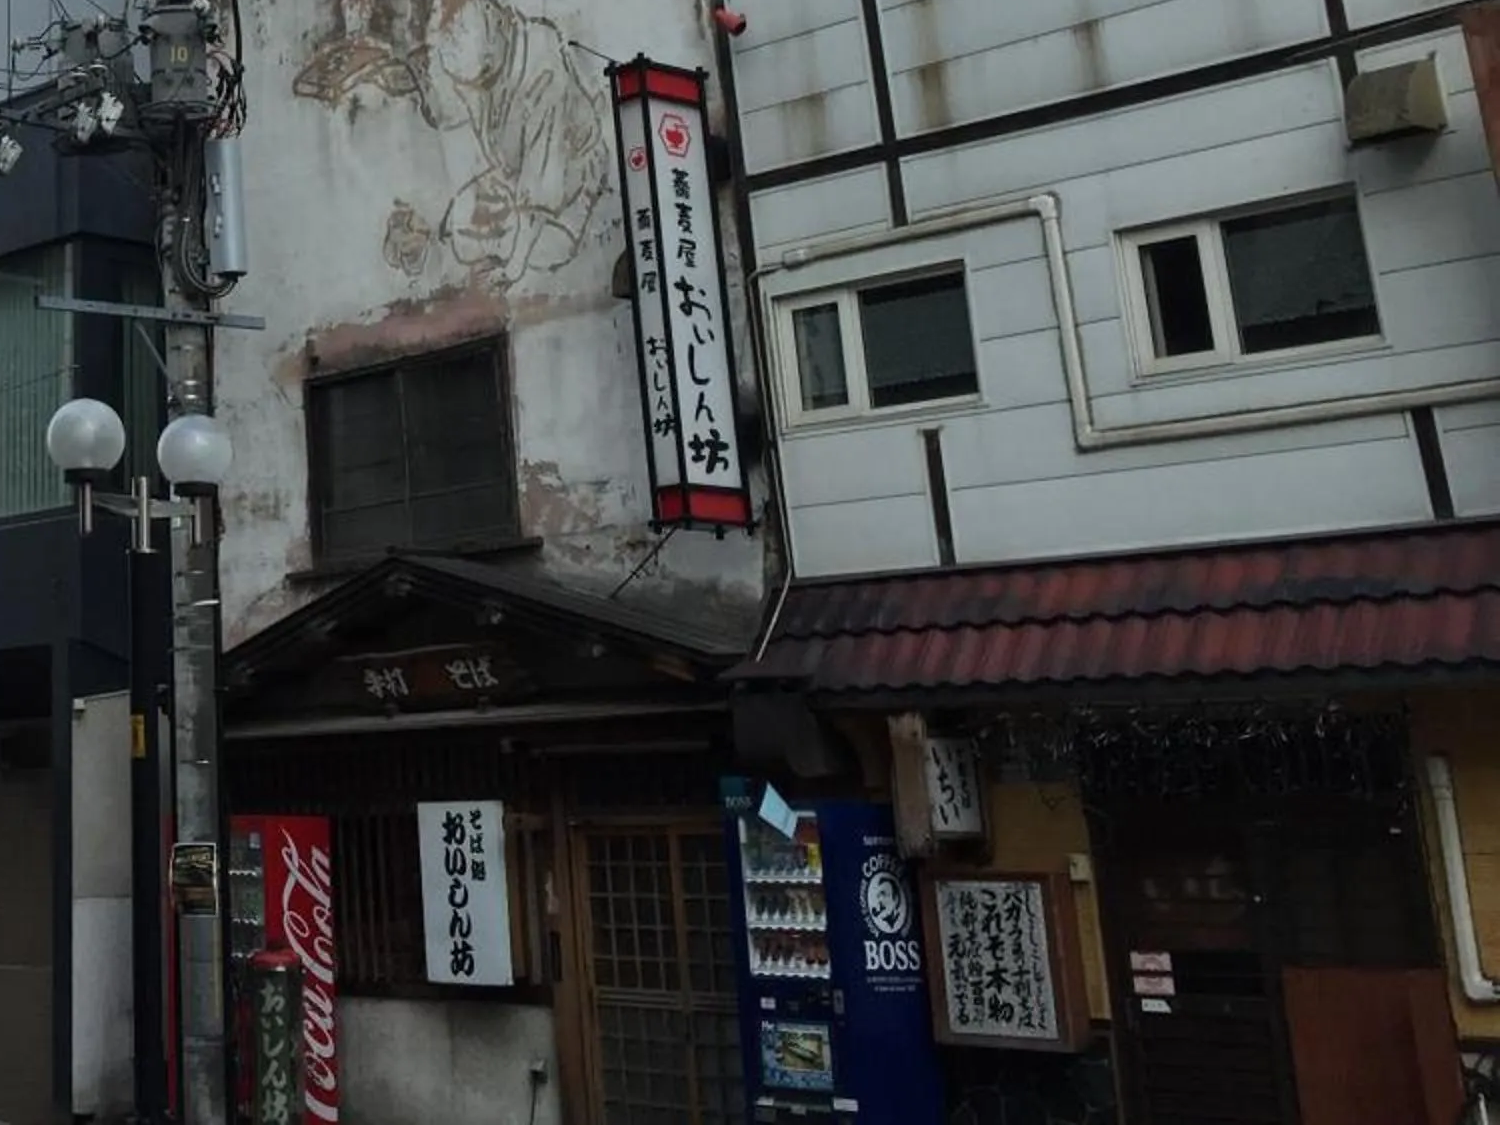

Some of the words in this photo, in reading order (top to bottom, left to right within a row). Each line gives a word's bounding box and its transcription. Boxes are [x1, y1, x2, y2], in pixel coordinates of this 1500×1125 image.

[674, 275, 731, 474] おいしん坊
[442, 810, 476, 977] おいしん坊
[863, 939, 922, 972] BOSS
